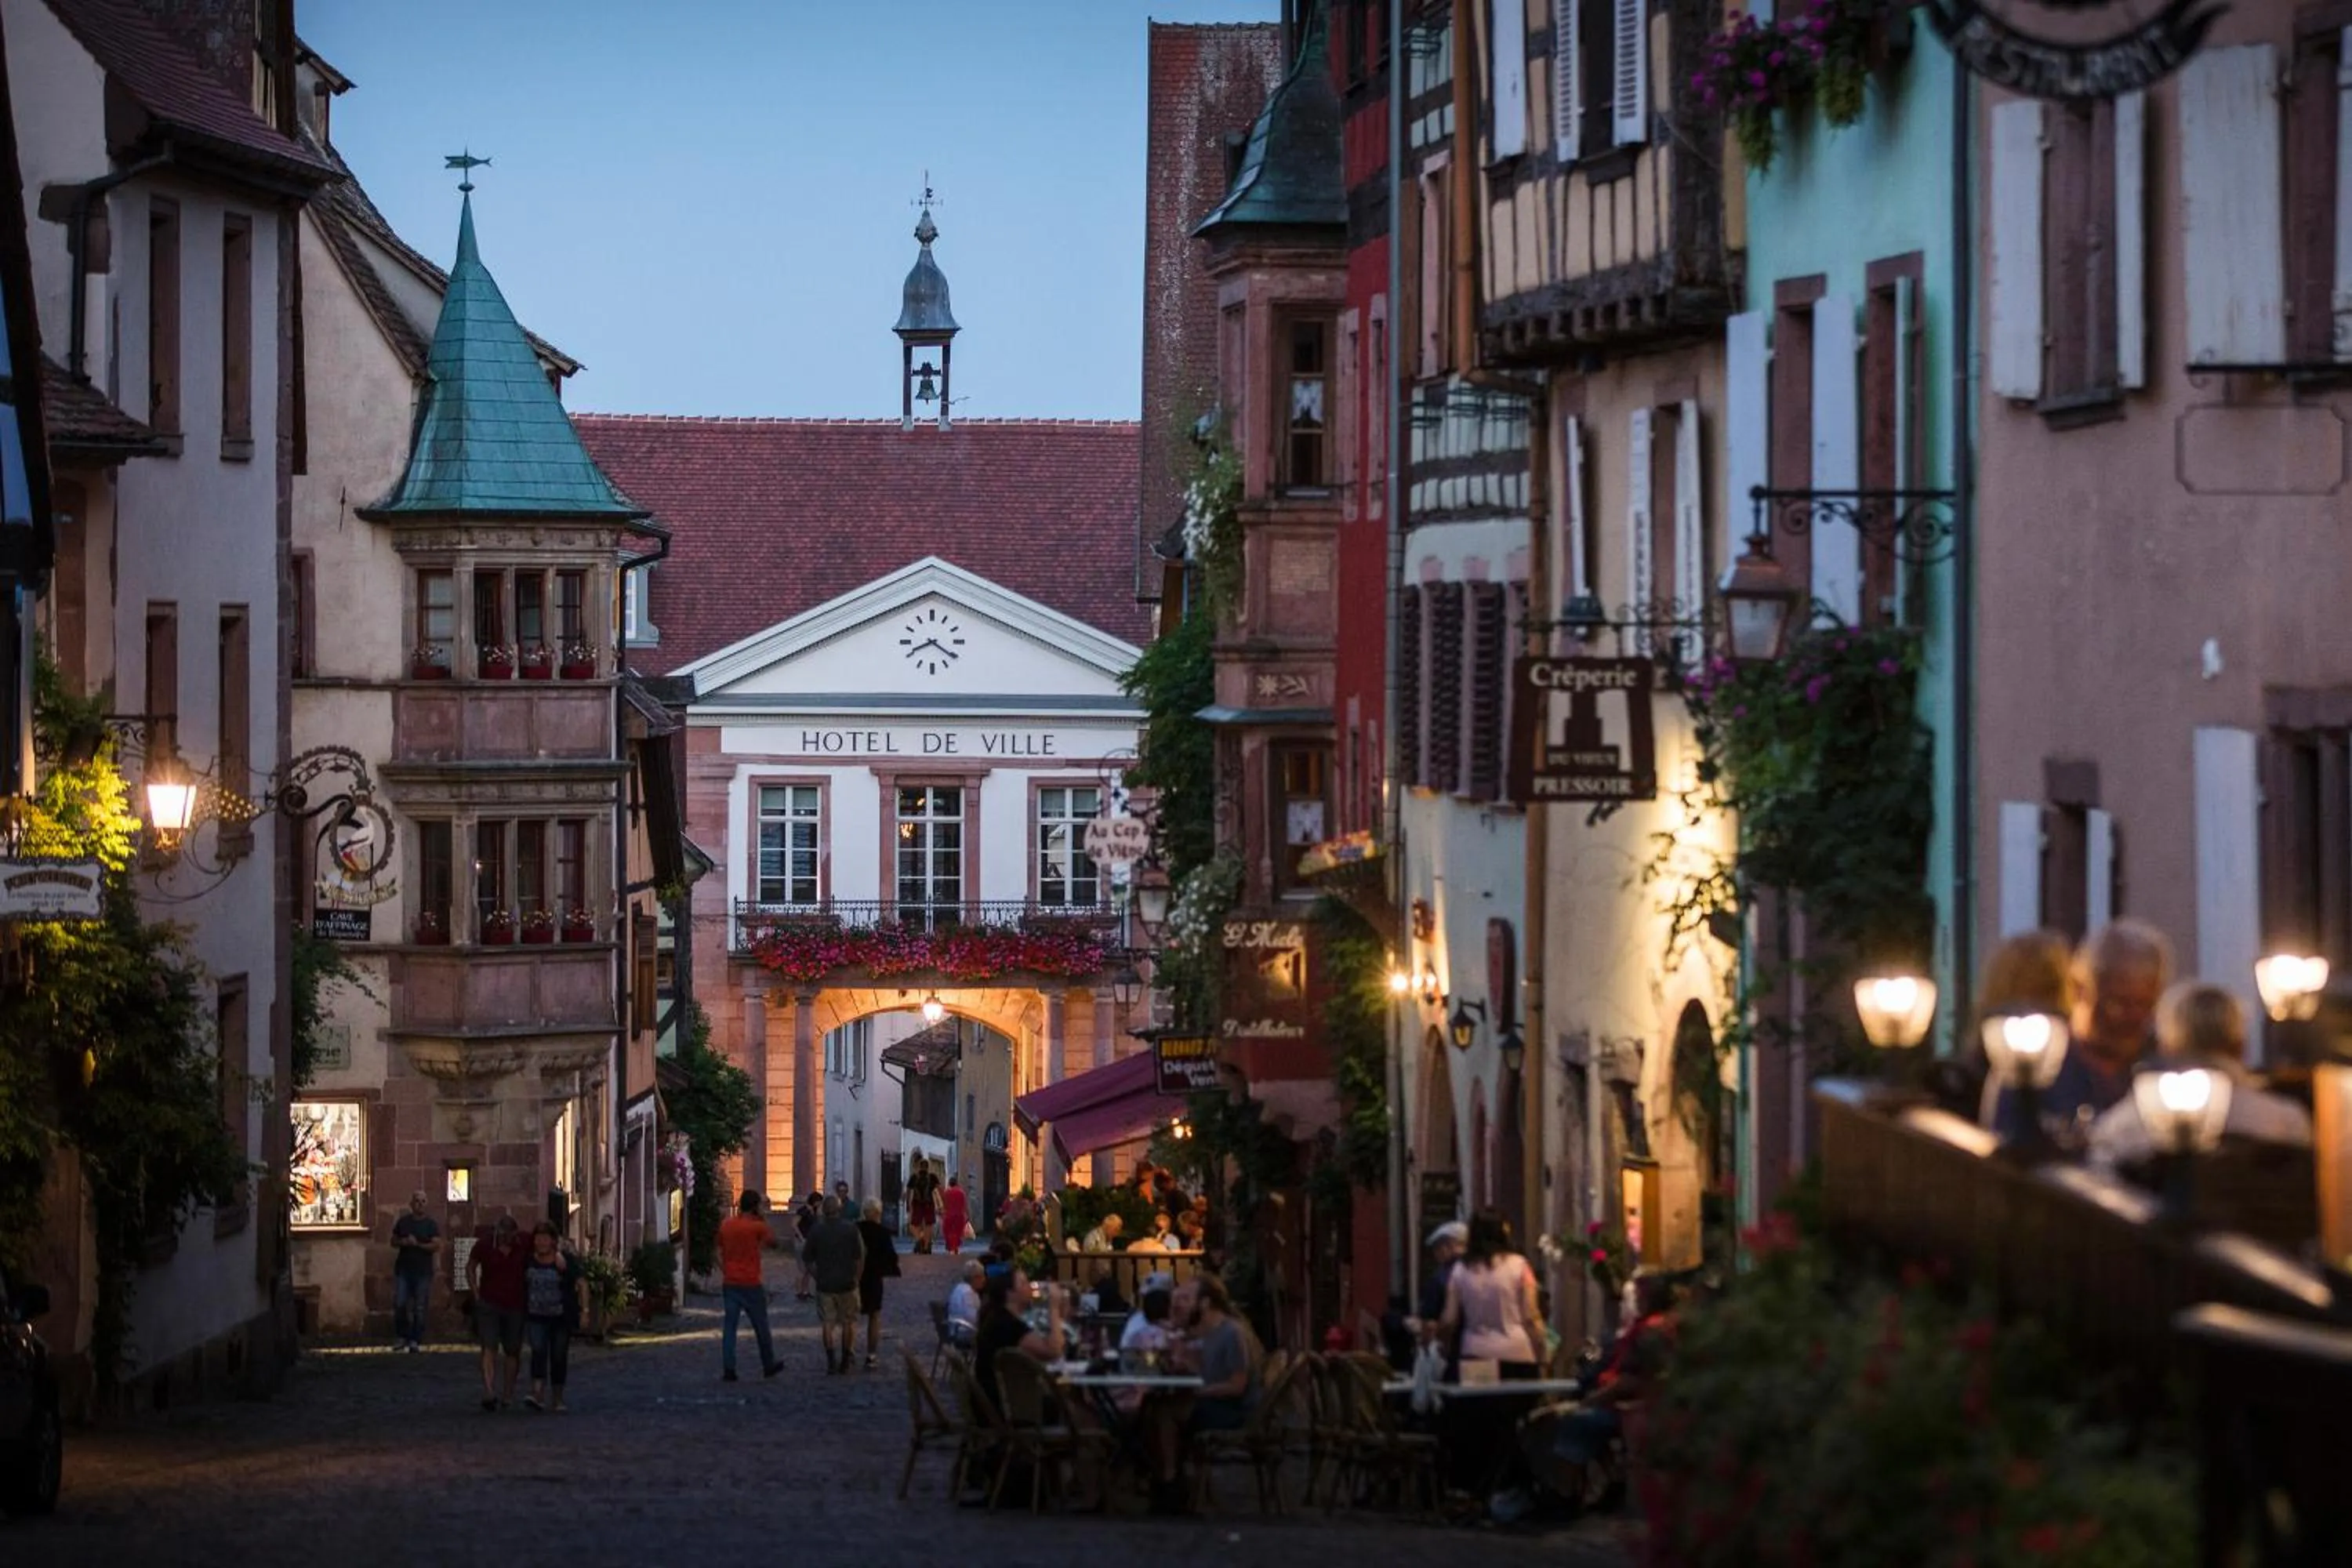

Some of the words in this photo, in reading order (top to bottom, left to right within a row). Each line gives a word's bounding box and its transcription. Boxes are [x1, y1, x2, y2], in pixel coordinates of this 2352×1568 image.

[1530, 662, 1637, 691] Crêperie
[802, 731, 898, 752] HOTEL
[923, 732, 958, 753] DE
[982, 734, 1055, 755] VILLE
[1163, 1058, 1215, 1077] Dégust
[1187, 1072, 1214, 1086] Ven
